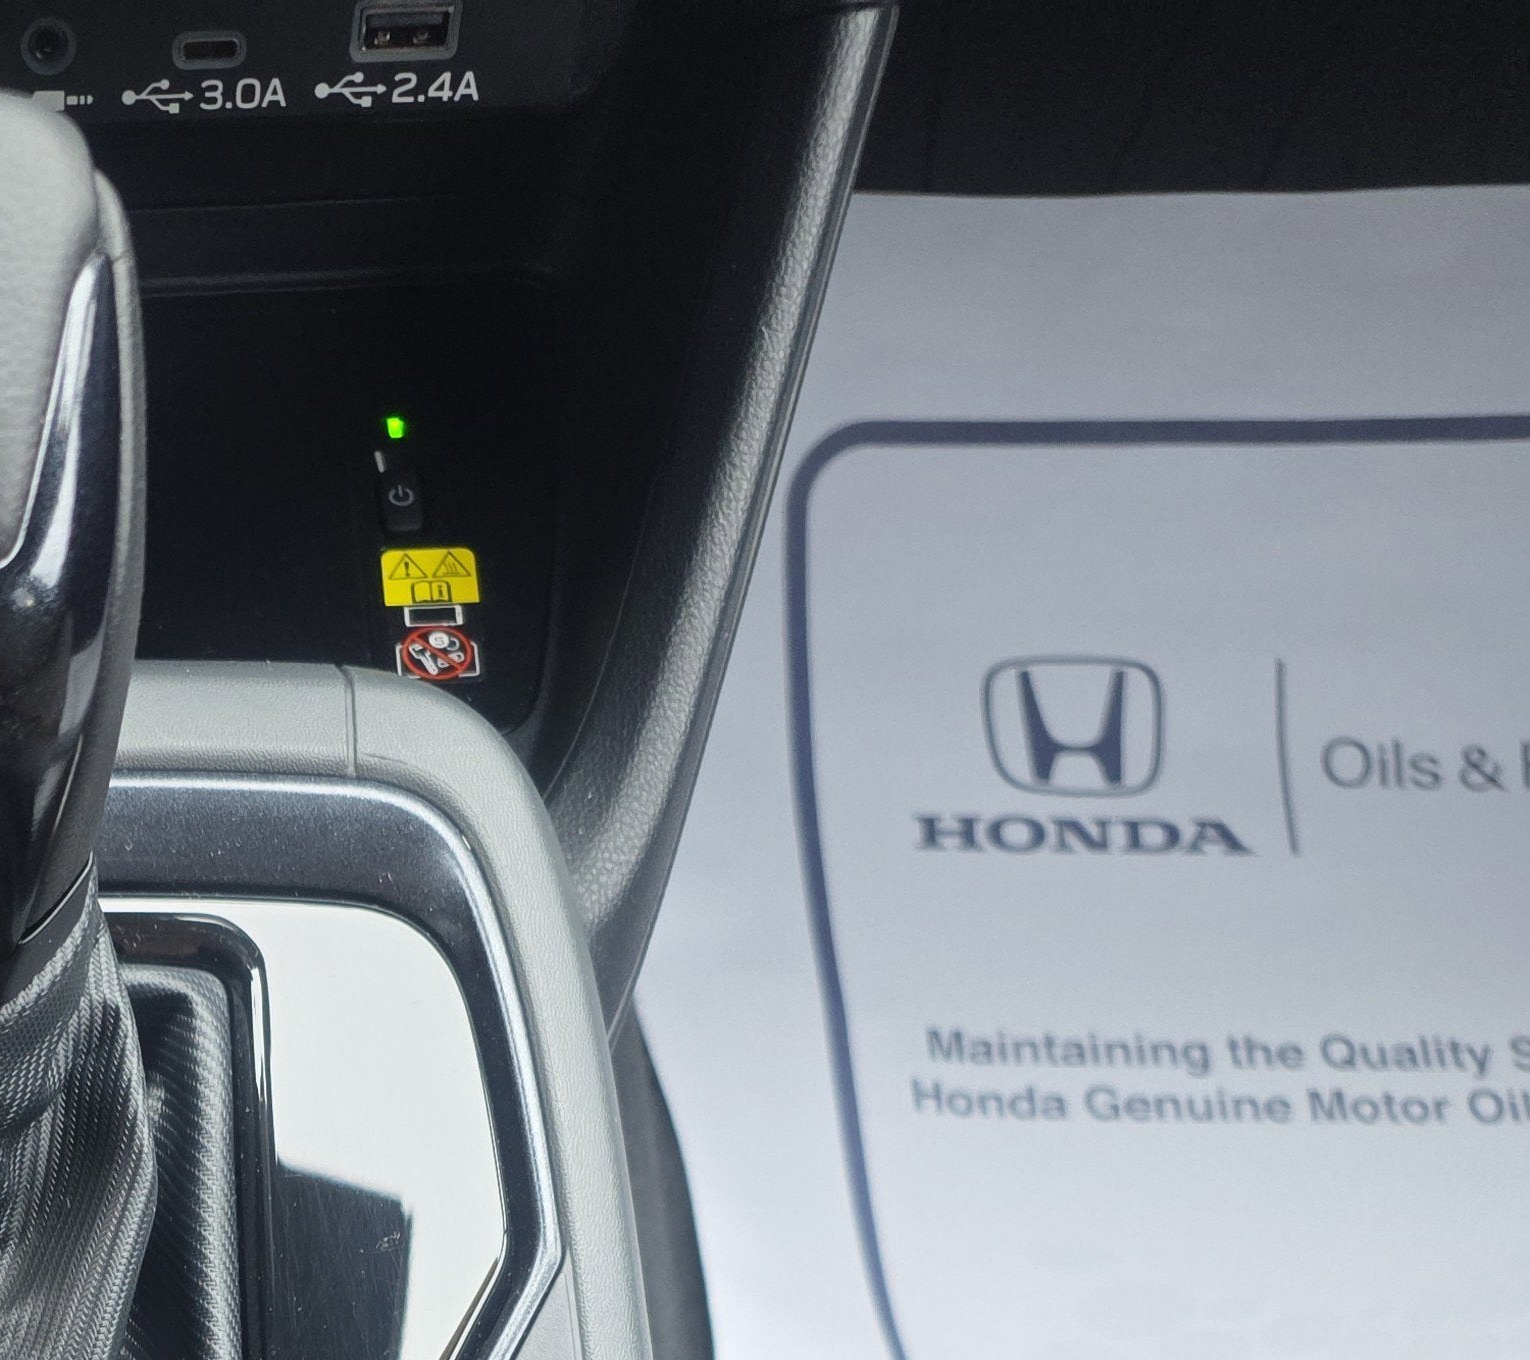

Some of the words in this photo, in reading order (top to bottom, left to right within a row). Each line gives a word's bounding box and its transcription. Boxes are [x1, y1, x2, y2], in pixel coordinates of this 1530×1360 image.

[199, 77, 286, 111] 3.0A
[391, 70, 480, 105] 2.4A
[1321, 735, 1443, 792] Oils
[1458, 743, 1509, 792] &
[913, 813, 1254, 856] HONDA
[926, 1027, 1212, 1077] Maintaining
[1227, 1036, 1305, 1071] the
[1320, 1033, 1494, 1080] Quality
[910, 1077, 1069, 1122] Honda
[1083, 1084, 1294, 1125] Genuine
[1307, 1086, 1448, 1126] Motor
